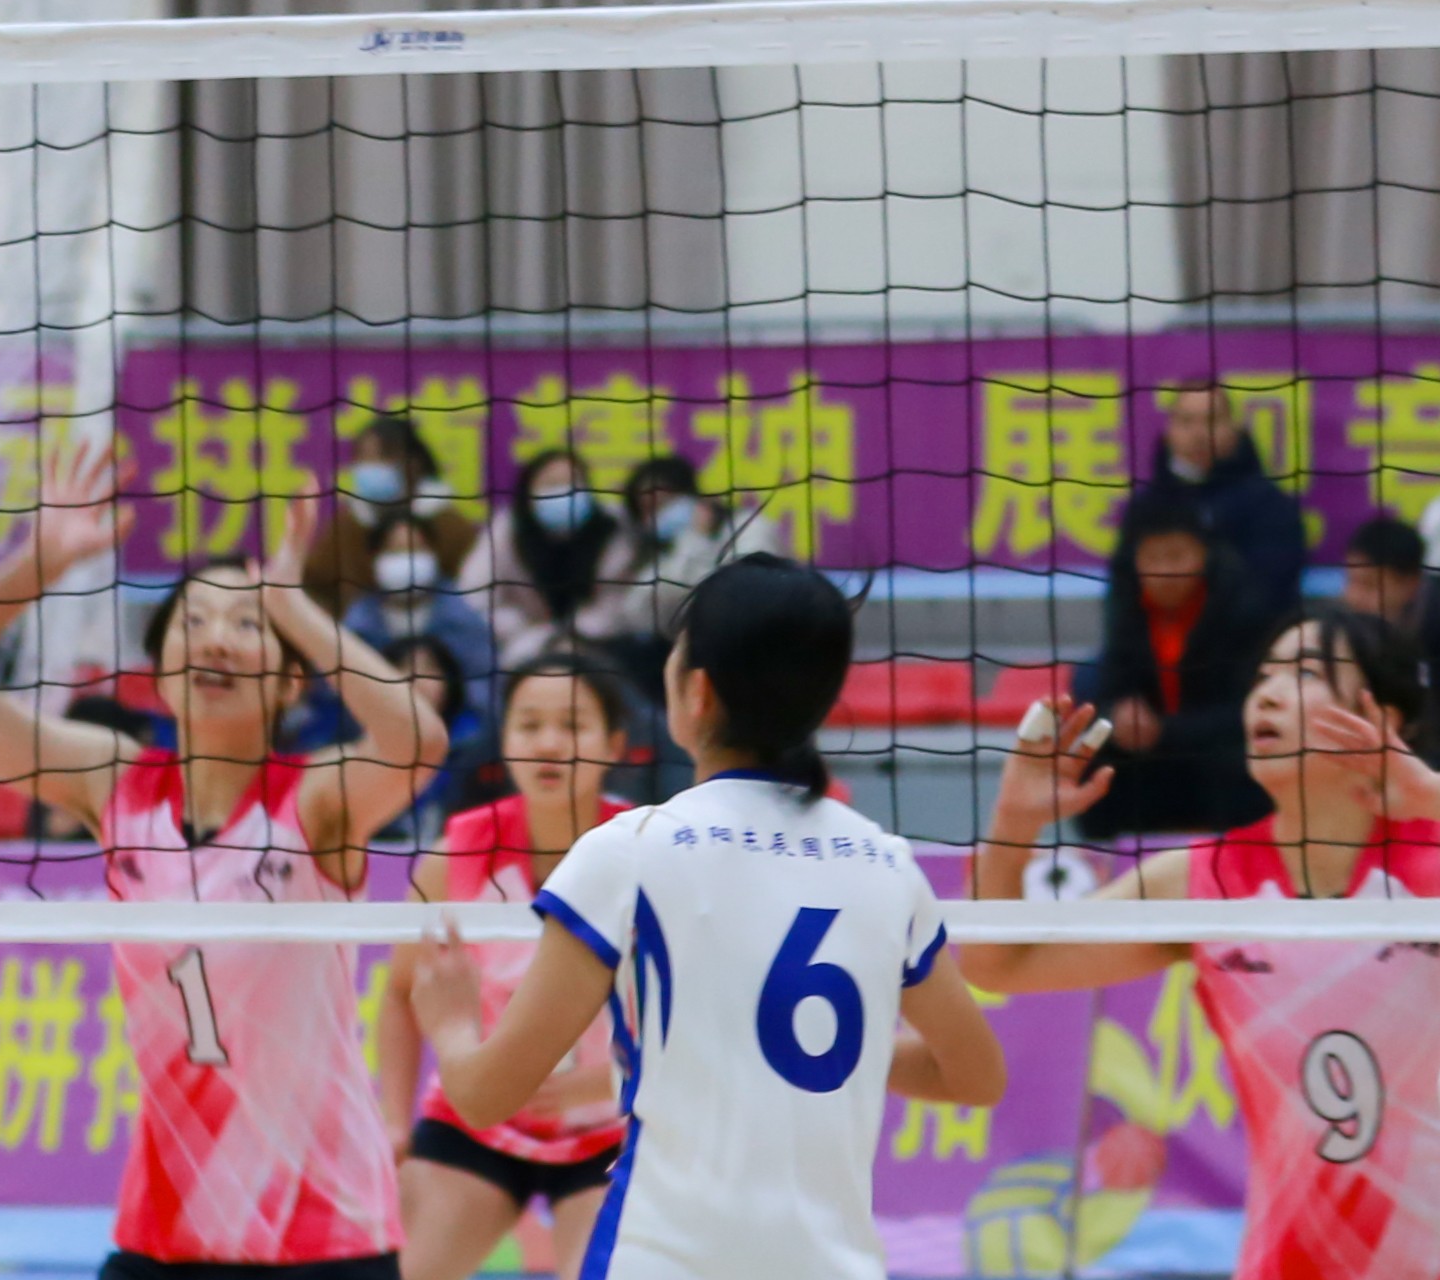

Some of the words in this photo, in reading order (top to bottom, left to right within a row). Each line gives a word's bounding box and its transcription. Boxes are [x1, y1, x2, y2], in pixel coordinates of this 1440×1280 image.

[167, 944, 231, 1068] 1
[755, 907, 865, 1093] 6
[1300, 1029, 1385, 1164] 9
